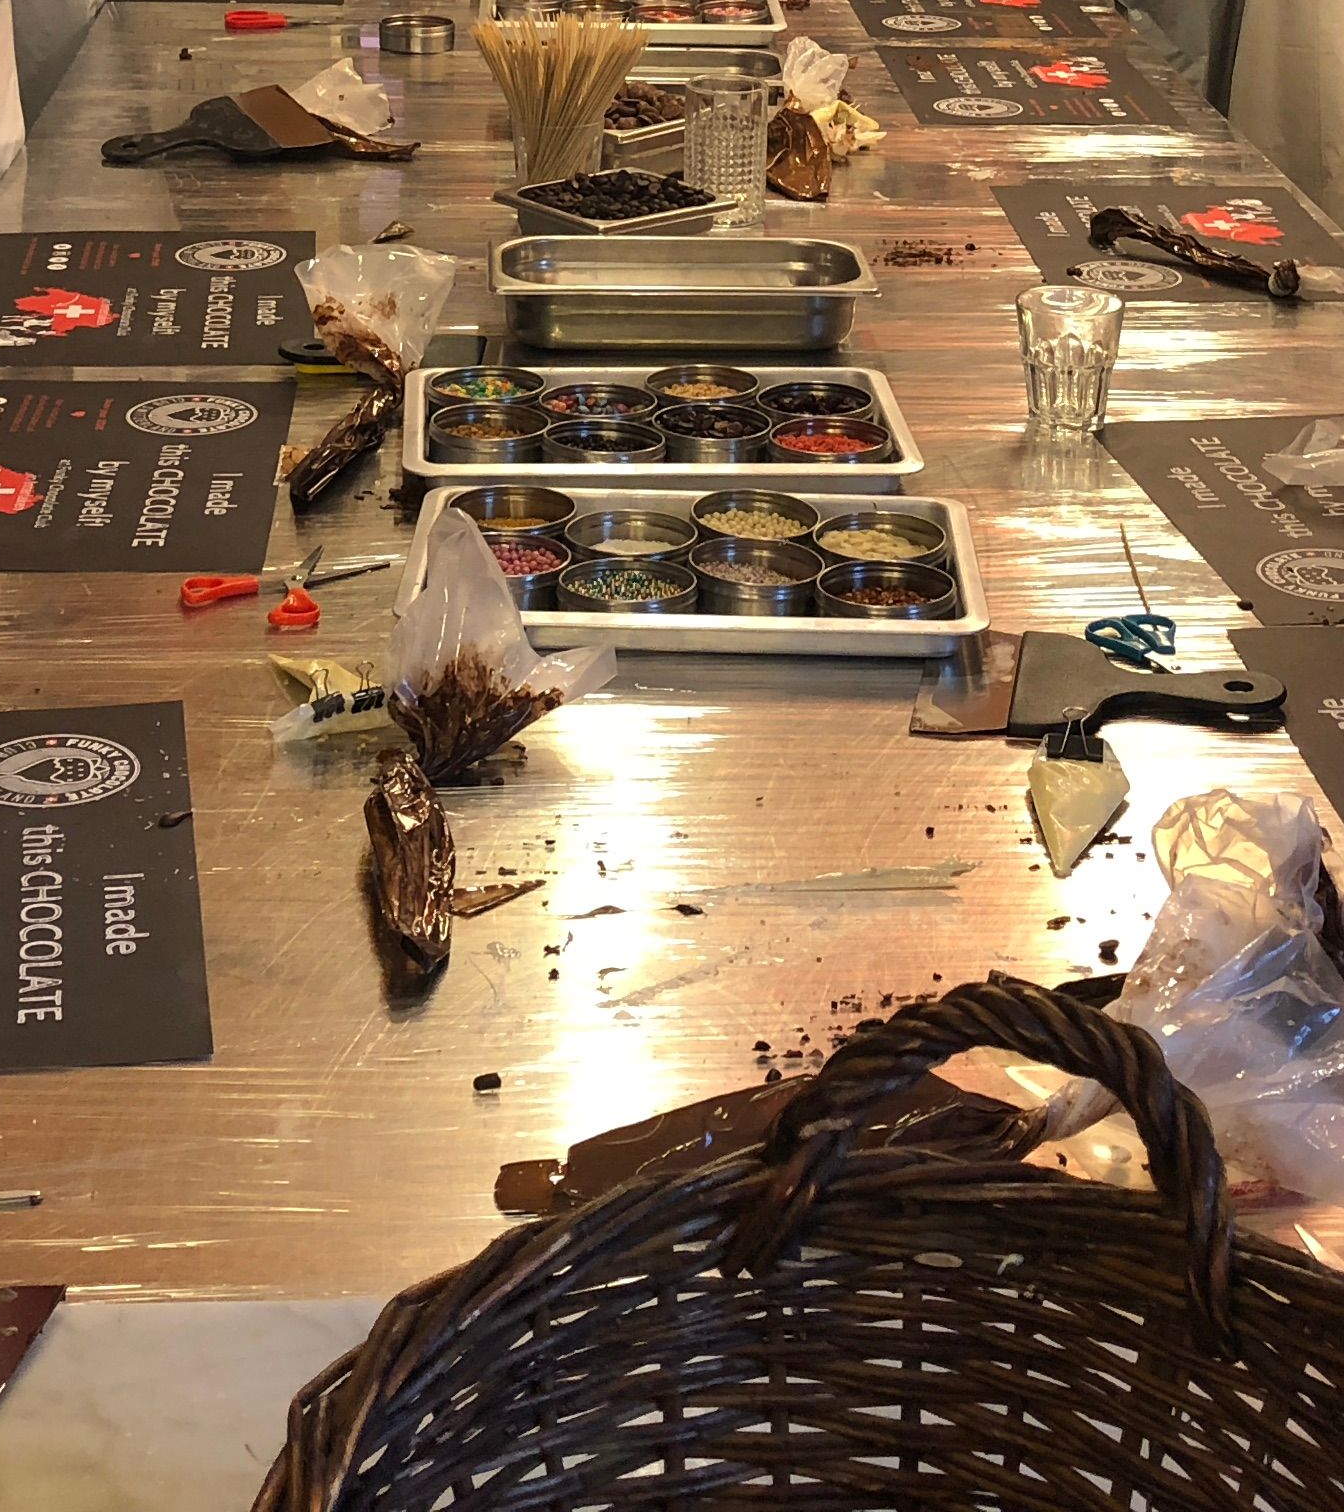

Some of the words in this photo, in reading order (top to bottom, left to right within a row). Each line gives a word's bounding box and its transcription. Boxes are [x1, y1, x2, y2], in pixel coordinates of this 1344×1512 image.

[150, 288, 186, 300] by
[209, 276, 236, 292] this
[201, 294, 234, 349] CHOCOLATE
[256, 300, 283, 325] made
[85, 461, 130, 476] by
[158, 444, 192, 466] this
[1167, 466, 1220, 501] made
[1189, 437, 1286, 510] CHOCOLATE
[76, 479, 113, 527] myself!
[131, 469, 184, 547] CHOCOLATE
[204, 480, 238, 515] made
[1270, 513, 1313, 539] this
[65, 738, 122, 759] FUNKY
[21, 824, 65, 867] this
[104, 885, 150, 956] made
[16, 870, 64, 1025] CHOCOLATE
